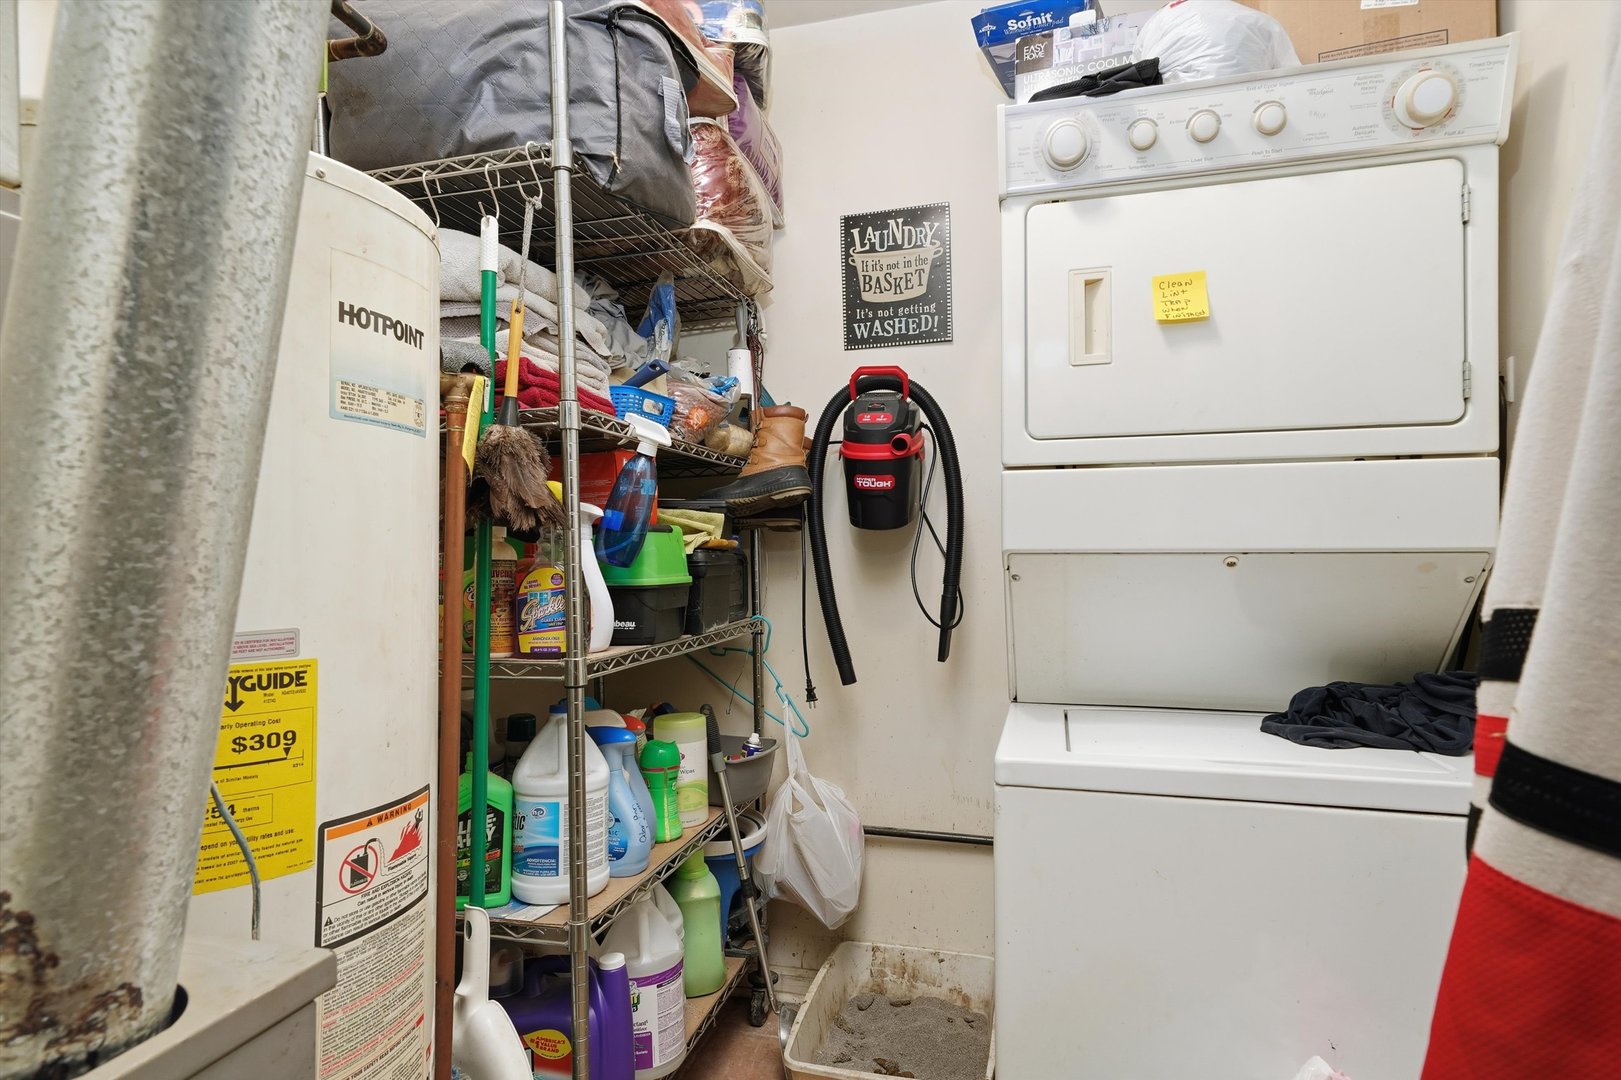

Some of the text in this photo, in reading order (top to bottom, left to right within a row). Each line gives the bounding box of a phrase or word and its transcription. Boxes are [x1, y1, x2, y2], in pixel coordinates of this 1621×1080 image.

[1007, 12, 1052, 30] Sofnit
[1024, 43, 1046, 54] EASY
[1024, 51, 1045, 62] HOME
[1024, 65, 1084, 84] ULTRASONIC
[1088, 58, 1120, 71] COOL
[851, 218, 940, 252] LAUNDRY
[861, 254, 928, 272] If it's not in the
[862, 268, 925, 295] BASKET
[856, 302, 936, 319] It's not getting
[338, 300, 424, 350] HOTPOINT
[853, 314, 939, 339] WASHED!
[226, 670, 308, 694] YGUIDE
[235, 720, 266, 729] Operating
[231, 730, 296, 755] $309
[377, 803, 412, 823] WARNING
[201, 842, 218, 851] epend
[536, 1036, 566, 1044] AMERICA'S
